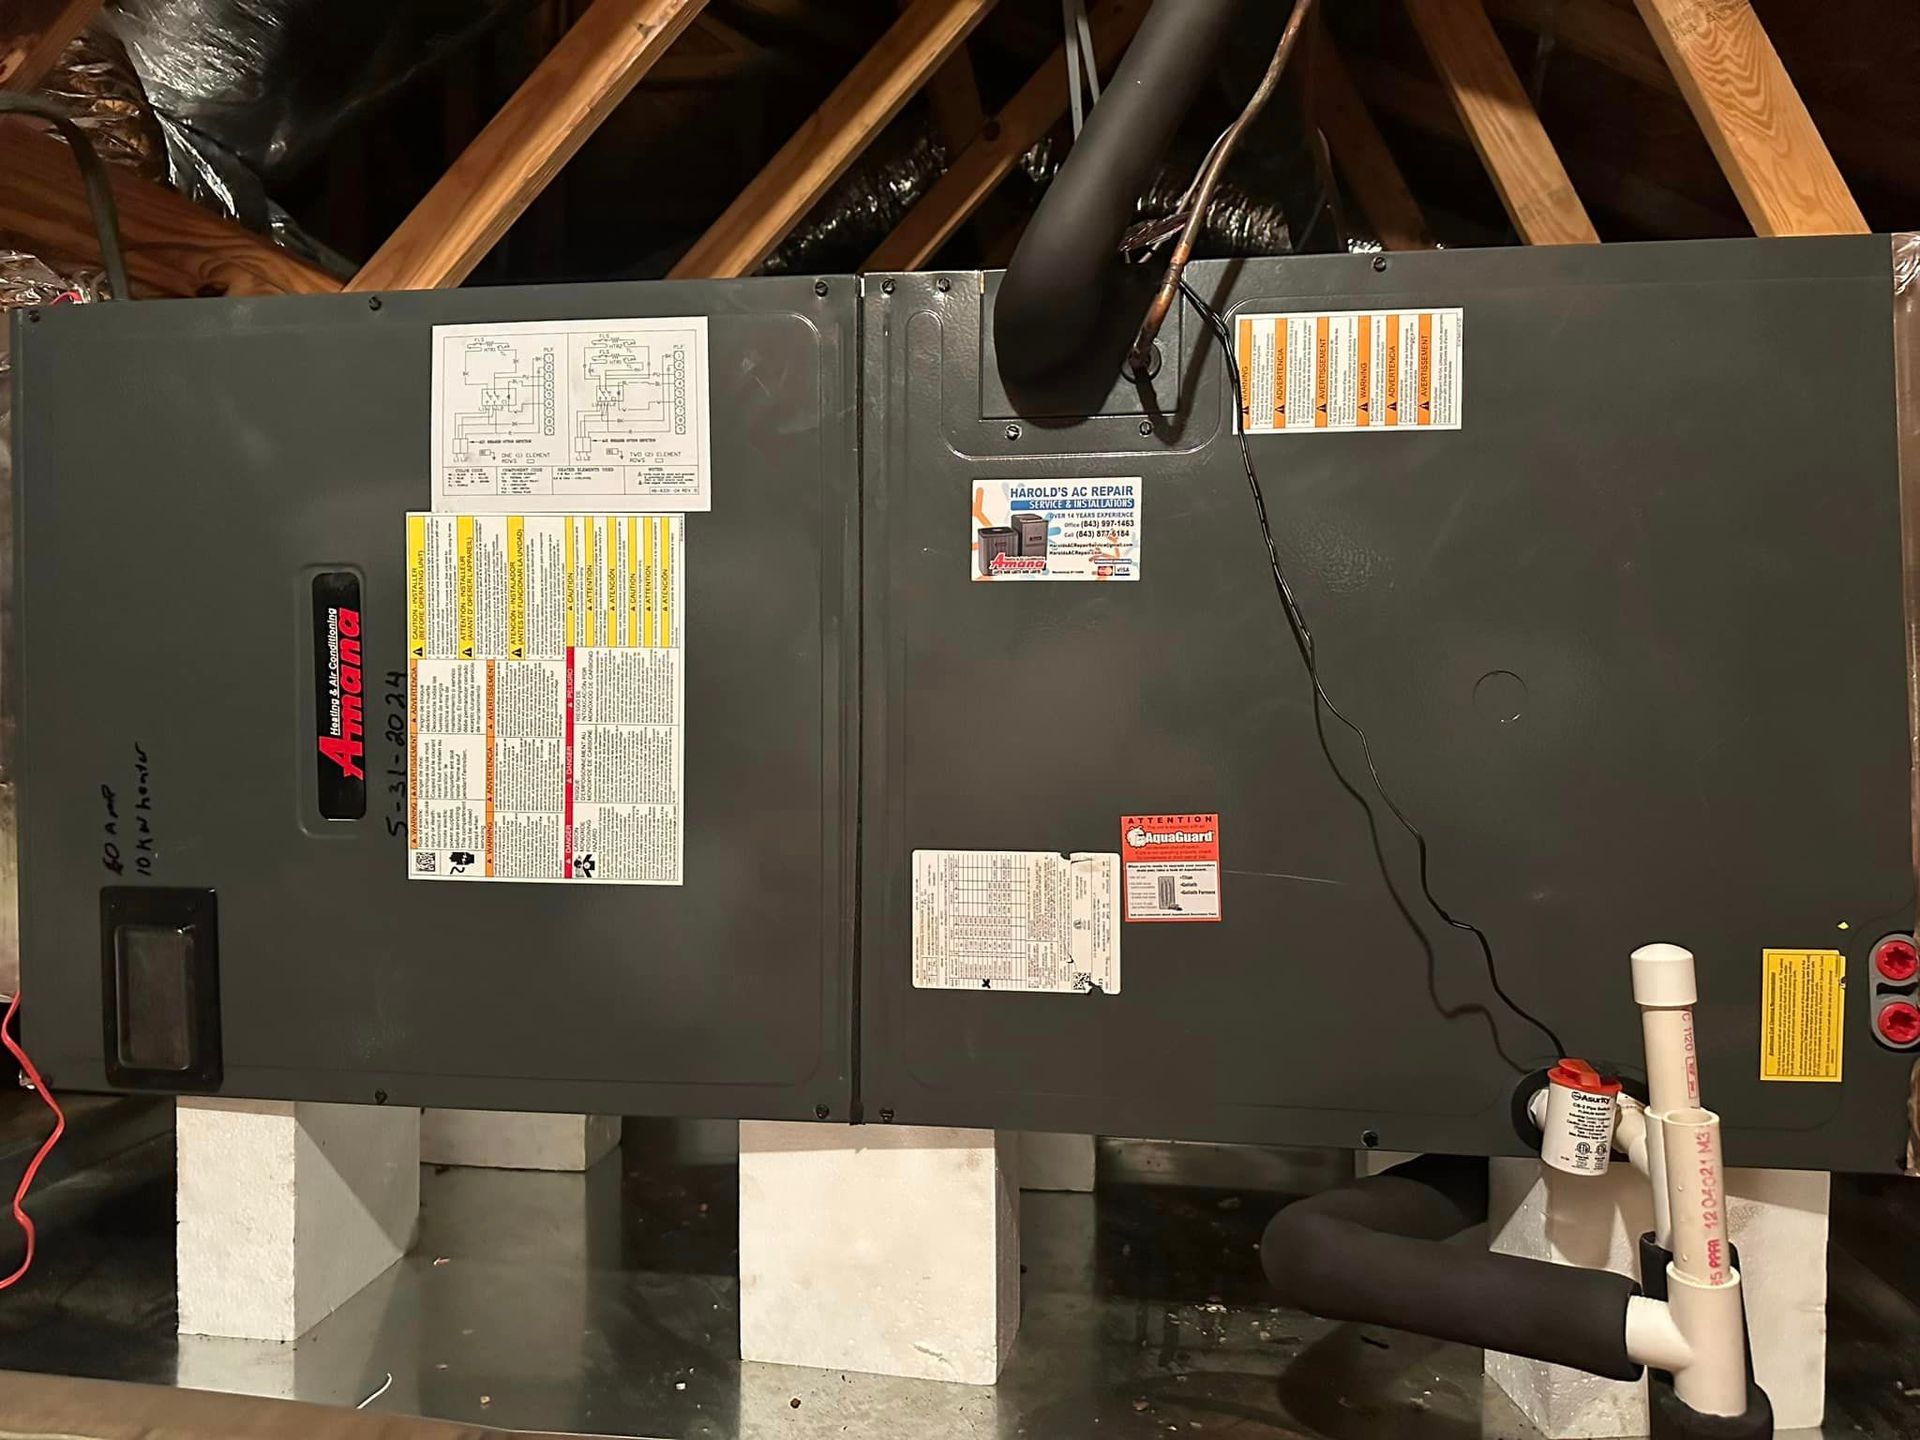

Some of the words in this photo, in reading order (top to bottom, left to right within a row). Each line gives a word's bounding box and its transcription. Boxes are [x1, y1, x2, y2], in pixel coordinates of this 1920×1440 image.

[1276, 348, 1284, 401] ADVERTENCIA
[1011, 487, 1068, 498] HAROLD'S
[1072, 487, 1087, 496] AC
[1092, 486, 1133, 496] REPAIR
[1029, 501, 1062, 509] SERVICE
[1066, 500, 1071, 508] &
[1074, 499, 1133, 509] INSTALLATIONS
[517, 558, 522, 567] LA
[991, 553, 1045, 568] Amana
[517, 610, 523, 619] DE
[327, 608, 339, 670] Conditioning
[328, 672, 338, 686] Air
[318, 607, 364, 780] Amana
[329, 689, 338, 697] &
[329, 699, 341, 736] Heating
[385, 670, 407, 837] 5-31-2024
[1145, 831, 1213, 844] AquaGuard
[137, 857, 151, 876] 10
[1684, 1026, 1693, 1051] 1120
[1581, 1095, 1610, 1104] Asurity
